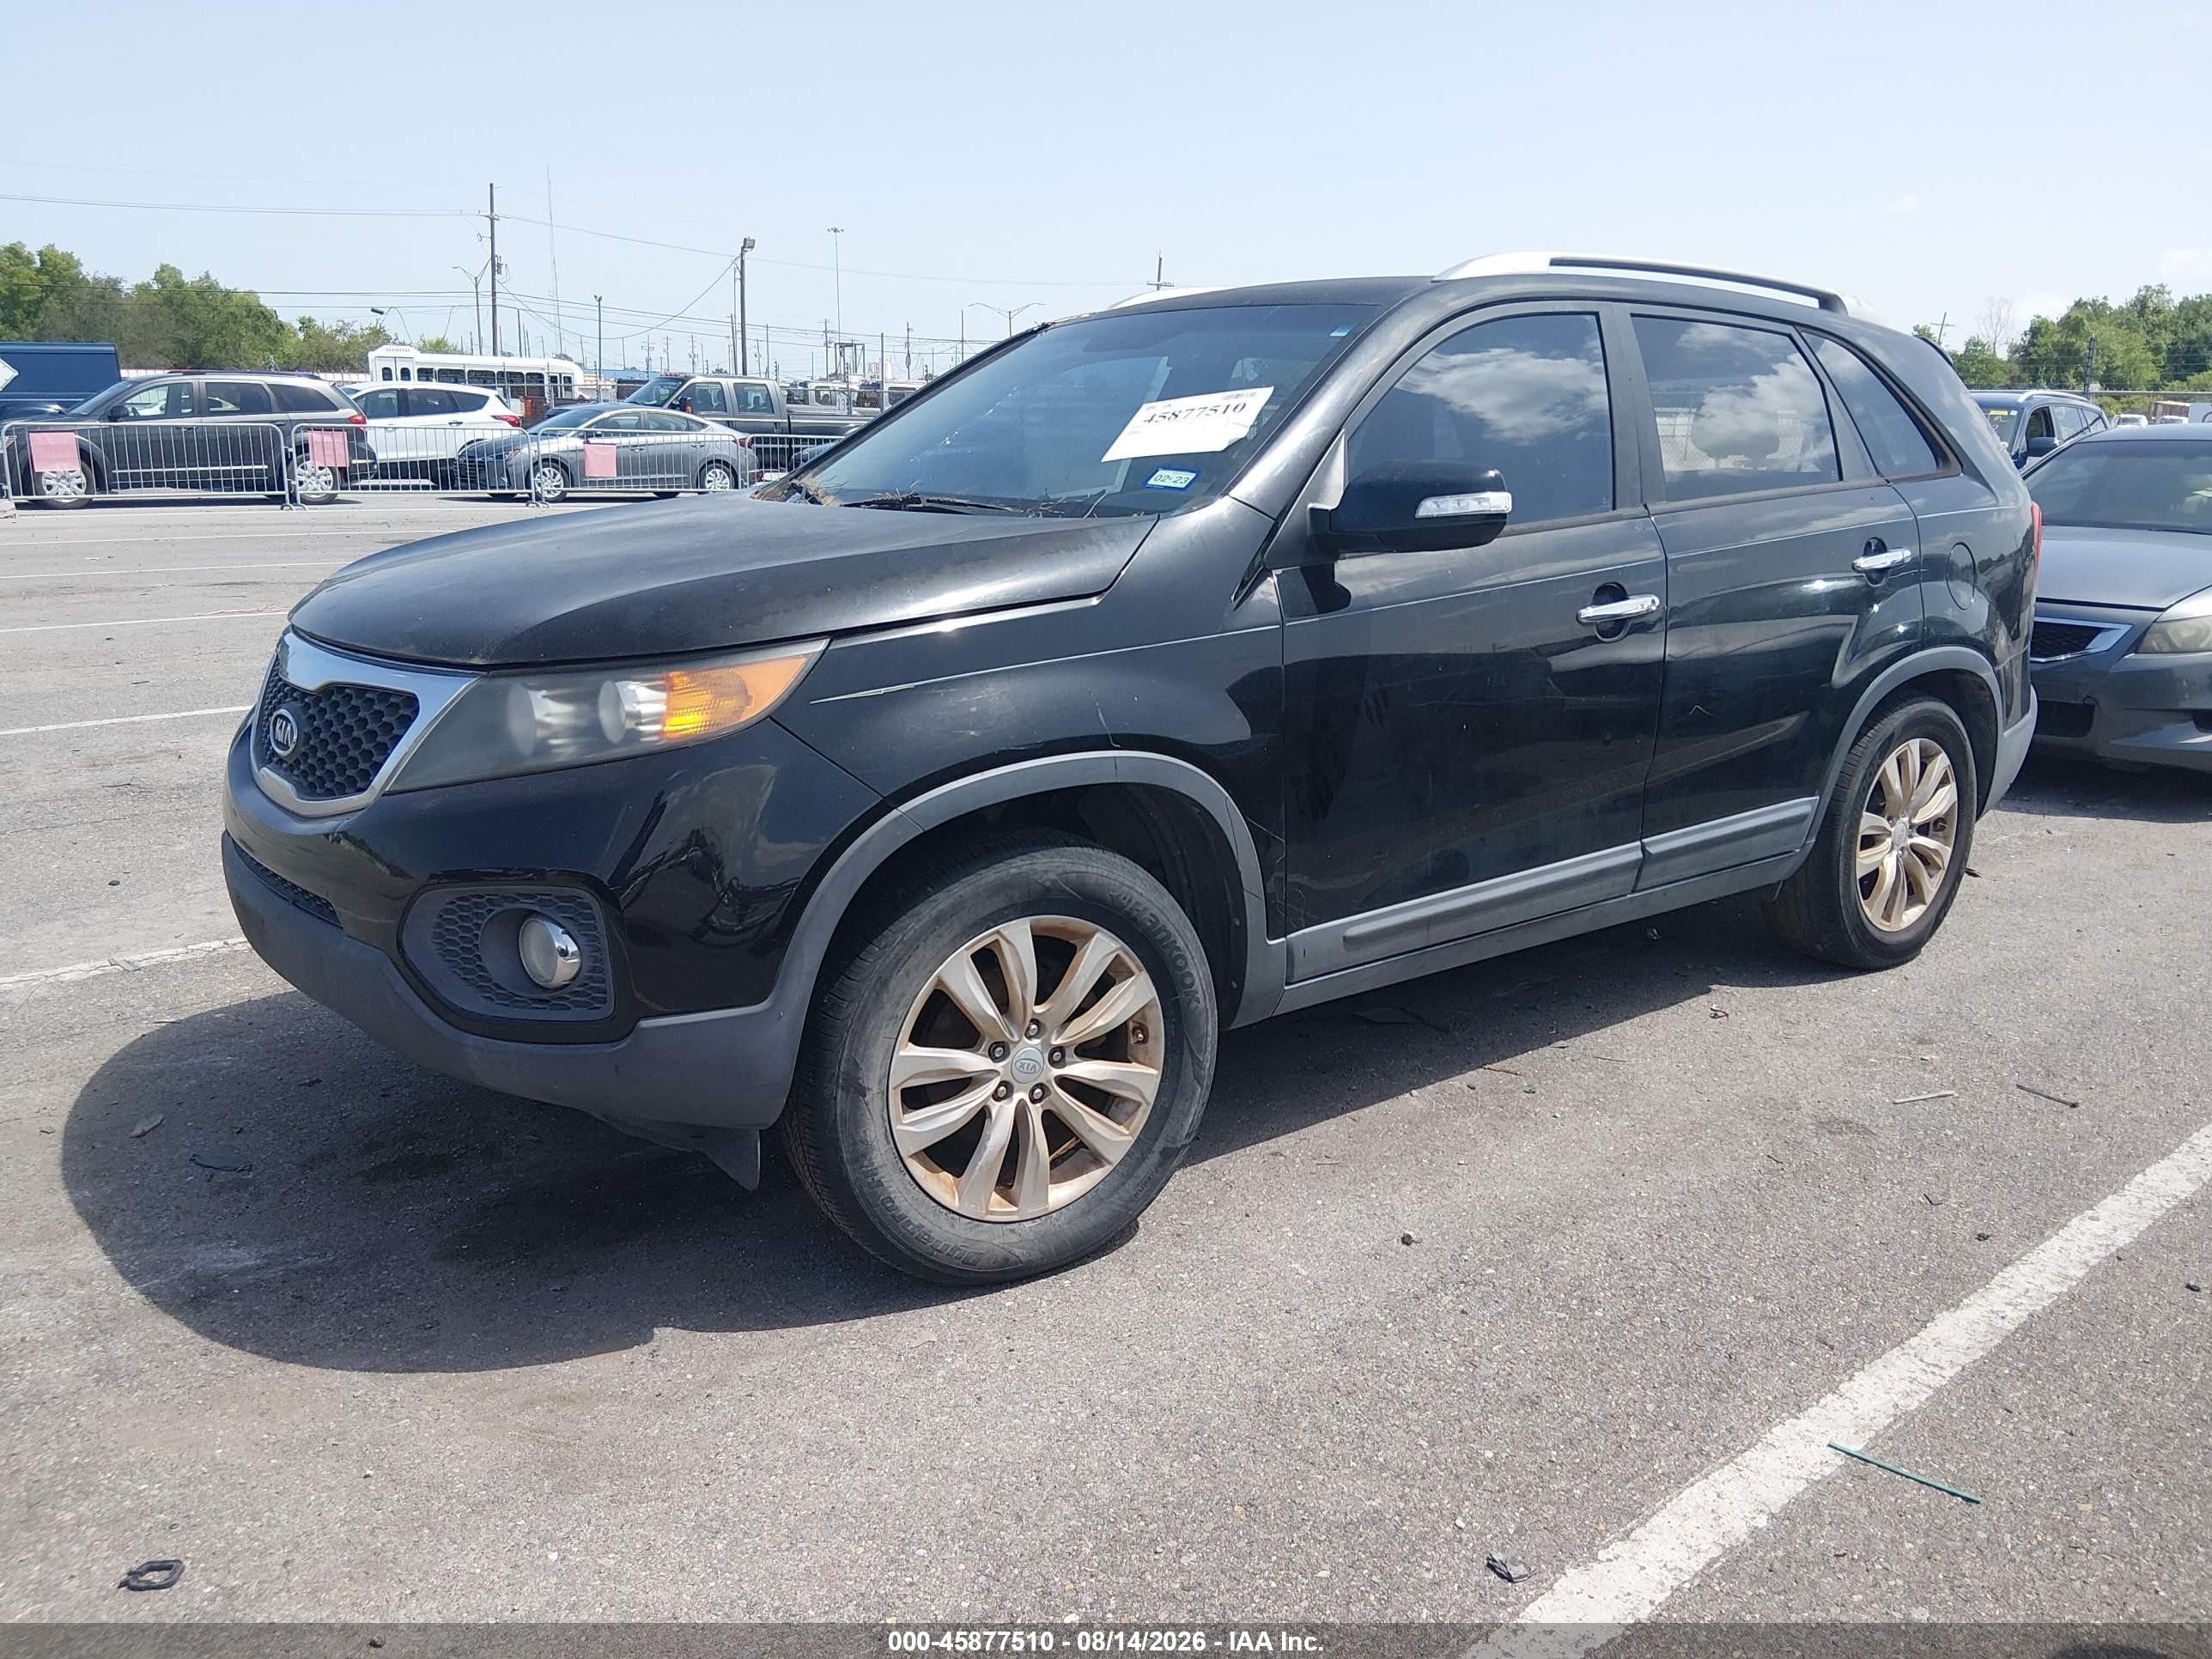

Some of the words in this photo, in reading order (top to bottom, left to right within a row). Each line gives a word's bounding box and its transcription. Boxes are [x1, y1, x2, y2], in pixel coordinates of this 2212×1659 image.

[1143, 401, 1248, 424] 45877510
[275, 717, 292, 747] KIA
[1018, 1060, 1036, 1073] KIA
